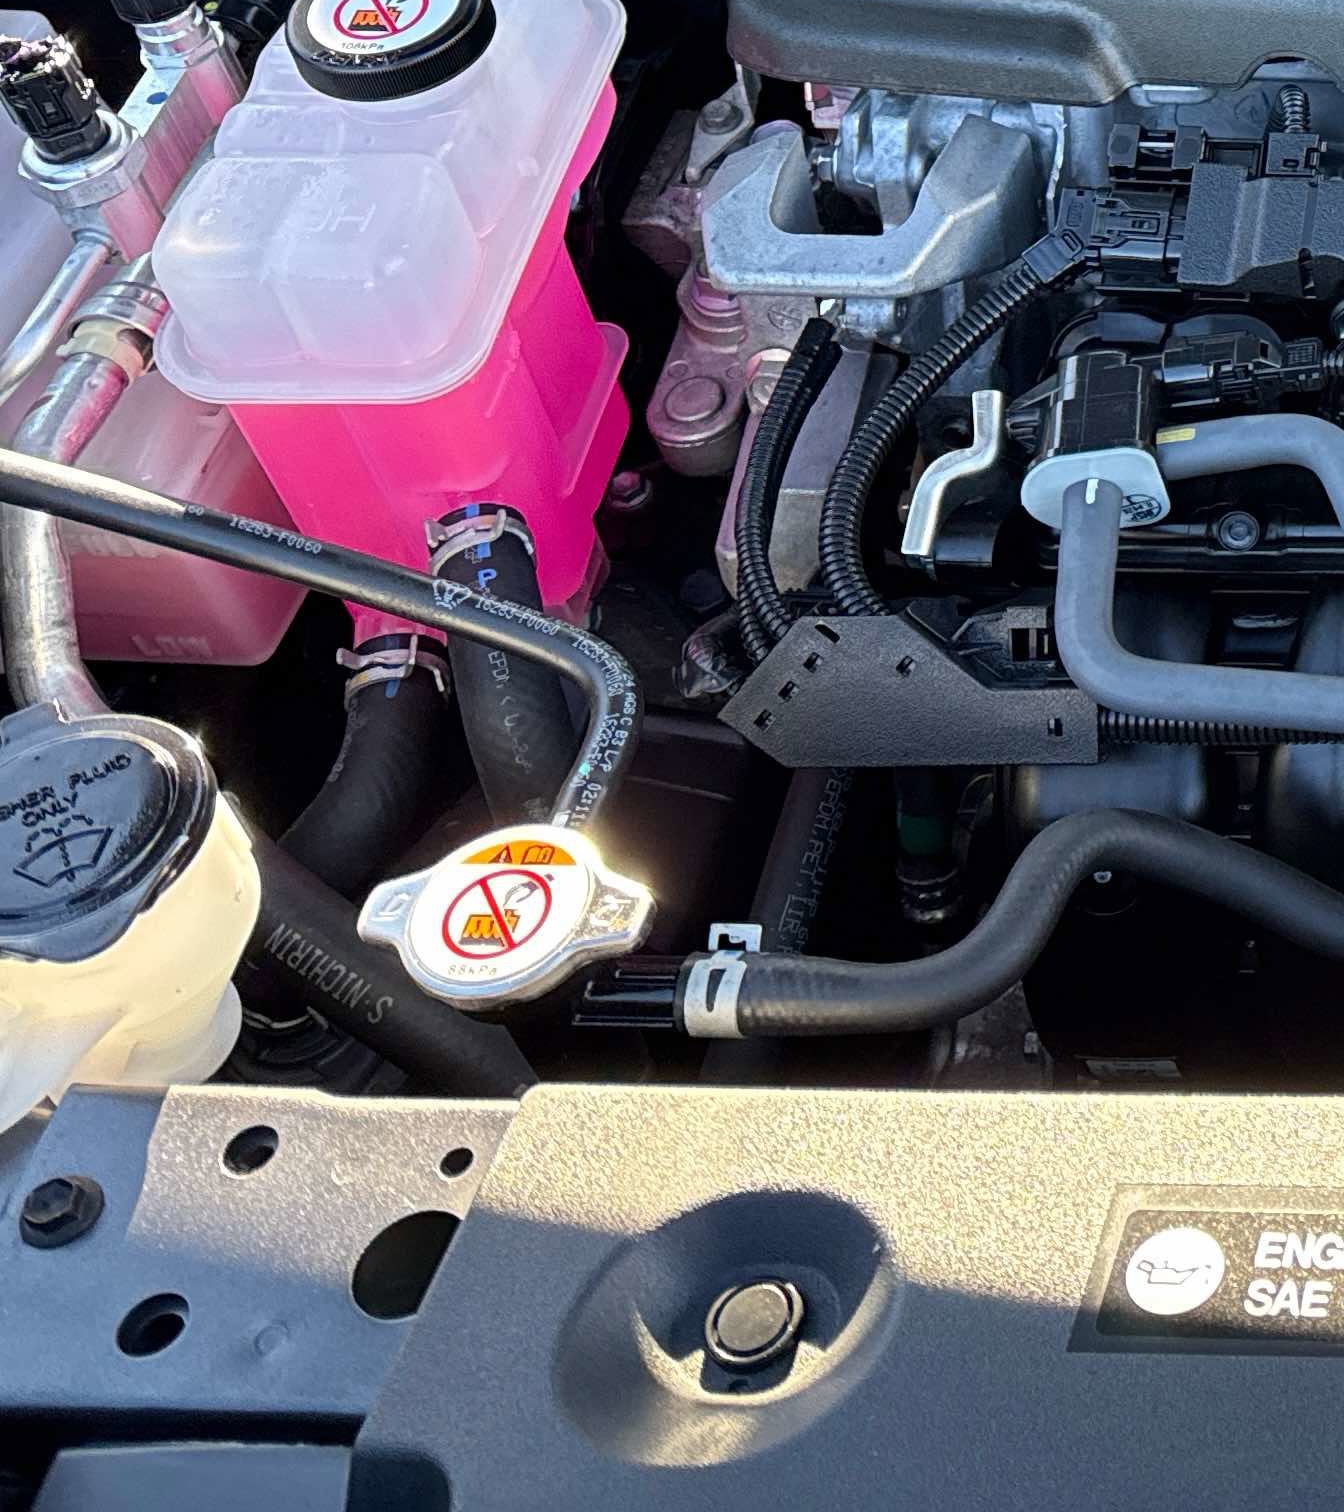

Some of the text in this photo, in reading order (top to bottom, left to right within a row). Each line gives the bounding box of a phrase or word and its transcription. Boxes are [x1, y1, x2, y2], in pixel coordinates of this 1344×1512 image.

[475, 595, 561, 637] 16283-F0060
[21, 791, 79, 828] ONLY
[1243, 1280, 1329, 1320] SAE
